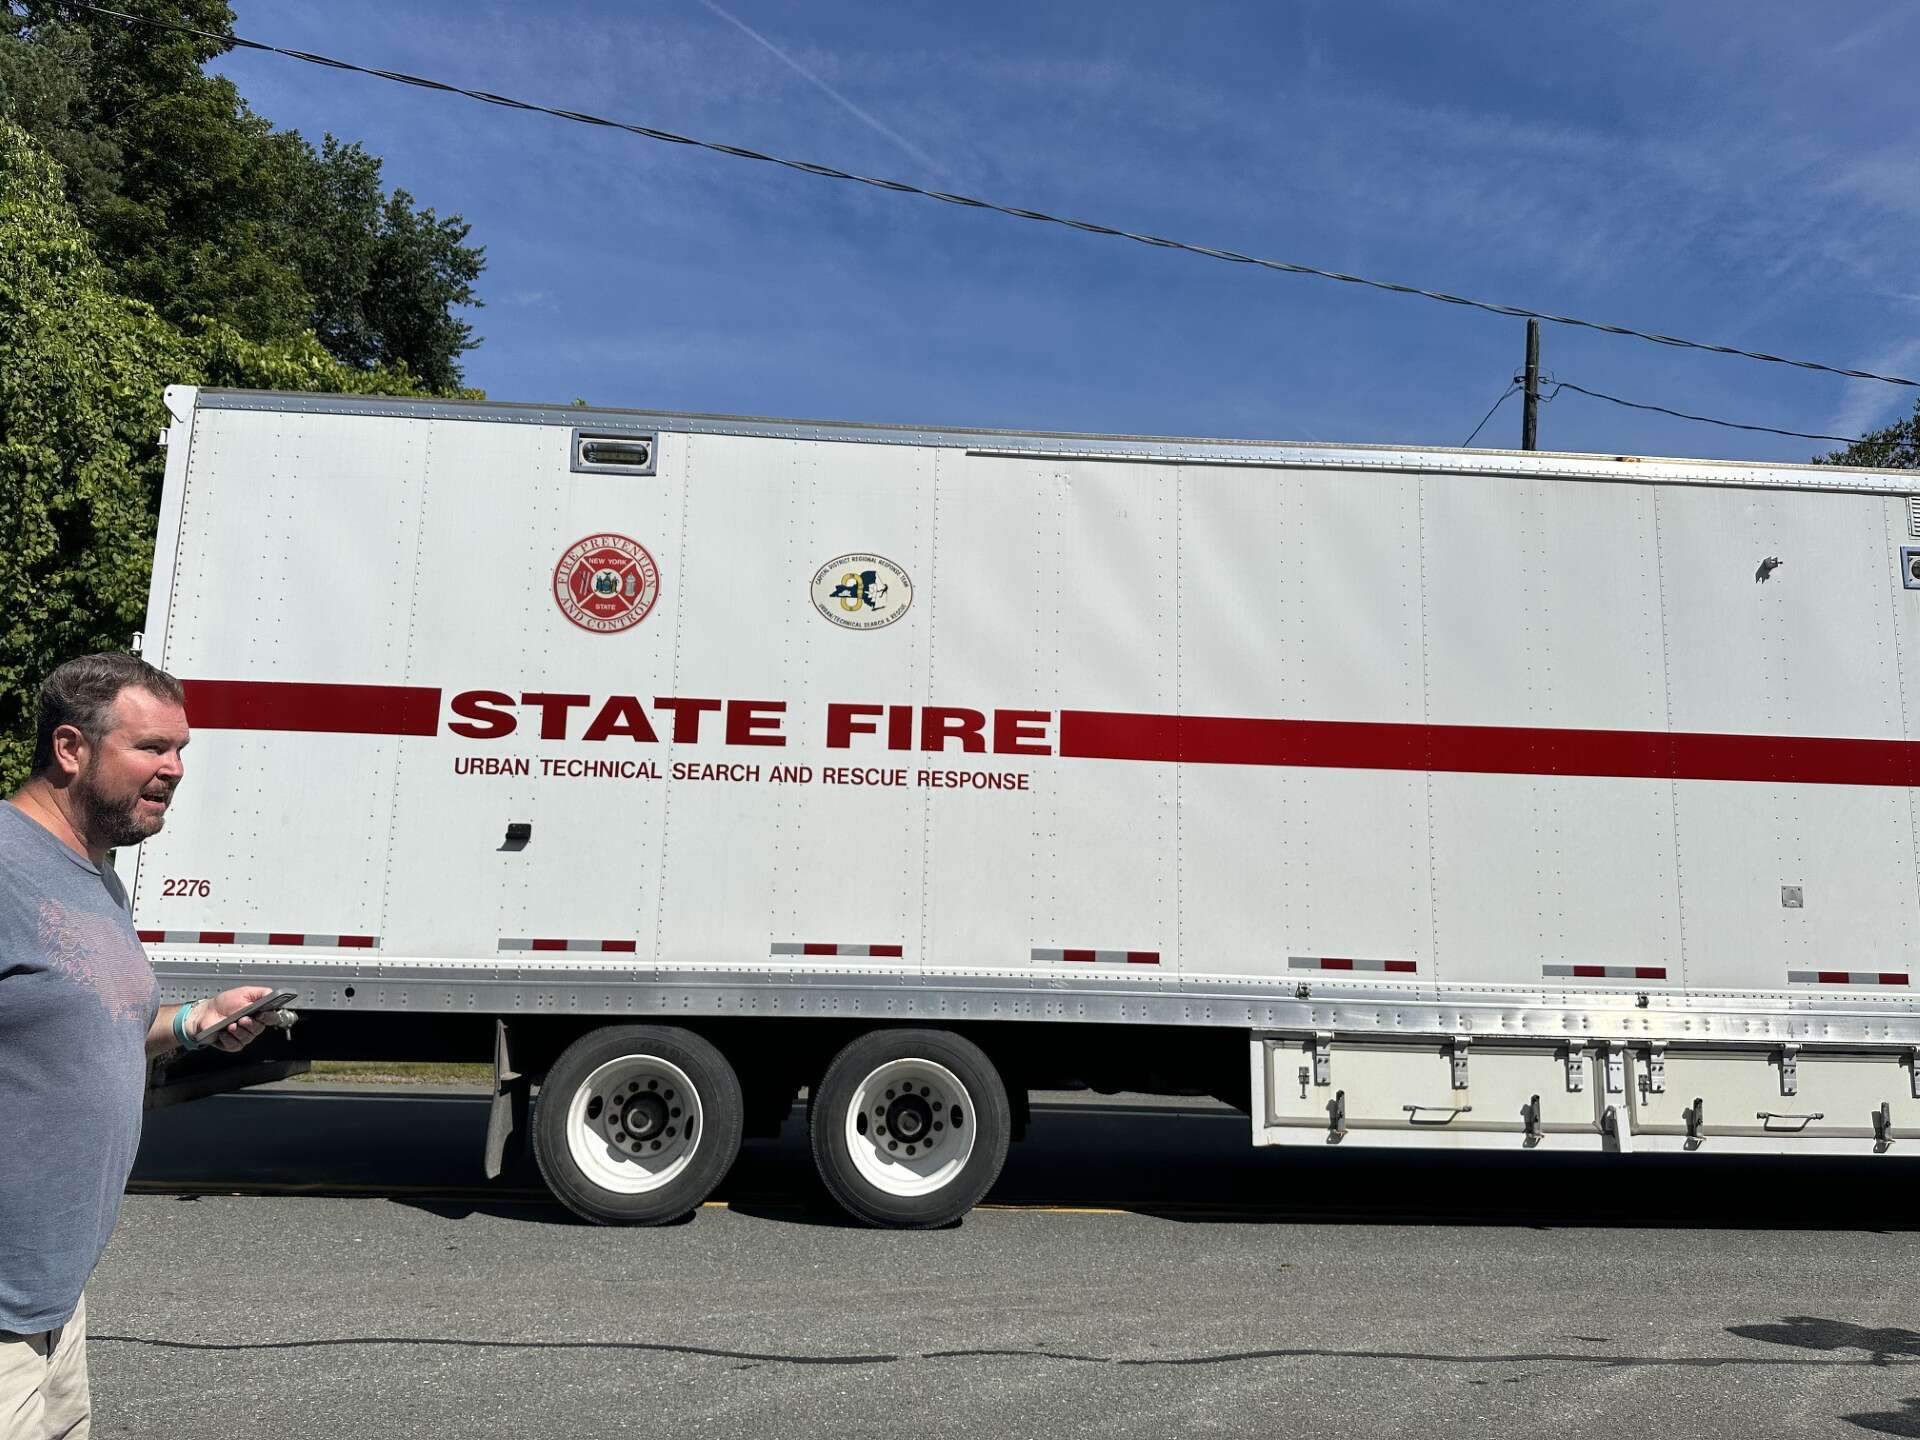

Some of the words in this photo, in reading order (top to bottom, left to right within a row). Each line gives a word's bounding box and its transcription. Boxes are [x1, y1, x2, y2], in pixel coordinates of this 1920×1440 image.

[557, 552, 579, 584] FIRE
[580, 536, 656, 588] PREVENTION
[588, 557, 605, 565] NEW
[561, 597, 583, 622] AND
[587, 599, 651, 629] CONTROL
[595, 603, 616, 611] STATE
[447, 690, 787, 747] STATE
[827, 703, 1052, 756] FIRE
[454, 757, 530, 776] URBAN
[540, 759, 663, 779] TECHNICAL
[672, 762, 761, 783] SEARCH
[769, 766, 813, 784] AND
[822, 767, 908, 787] RESCUE
[917, 770, 1030, 791] RESPONSE
[162, 879, 211, 898] 2276
